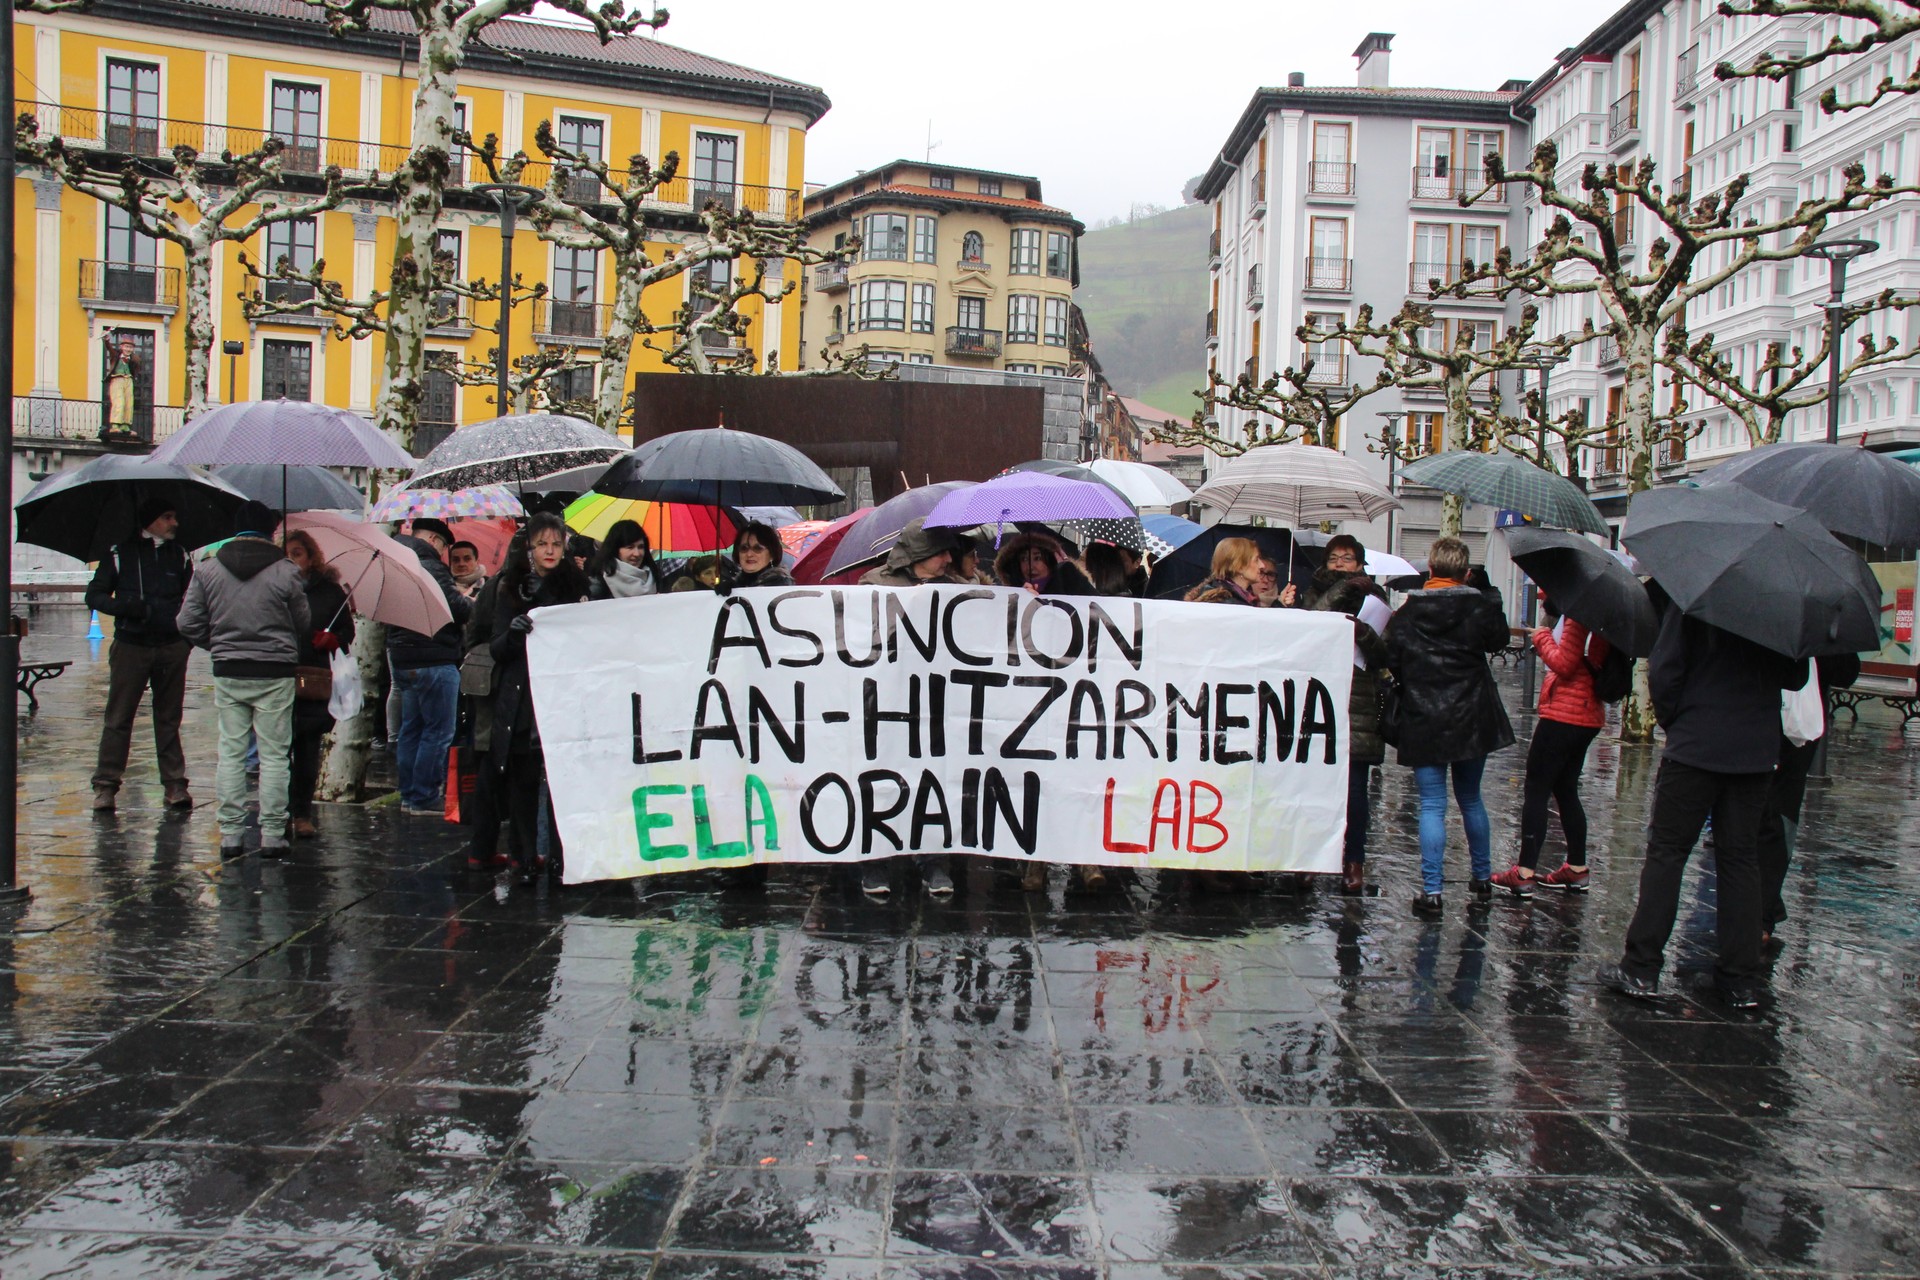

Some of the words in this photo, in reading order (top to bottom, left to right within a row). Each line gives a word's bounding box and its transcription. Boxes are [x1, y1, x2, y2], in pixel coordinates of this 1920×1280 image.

[706, 589, 1143, 675] ASUNCION
[631, 668, 1338, 766] LAN-HITZARMENA
[631, 774, 780, 861] ELA
[799, 766, 1041, 856] ORAIN
[1102, 777, 1230, 855] LAB
